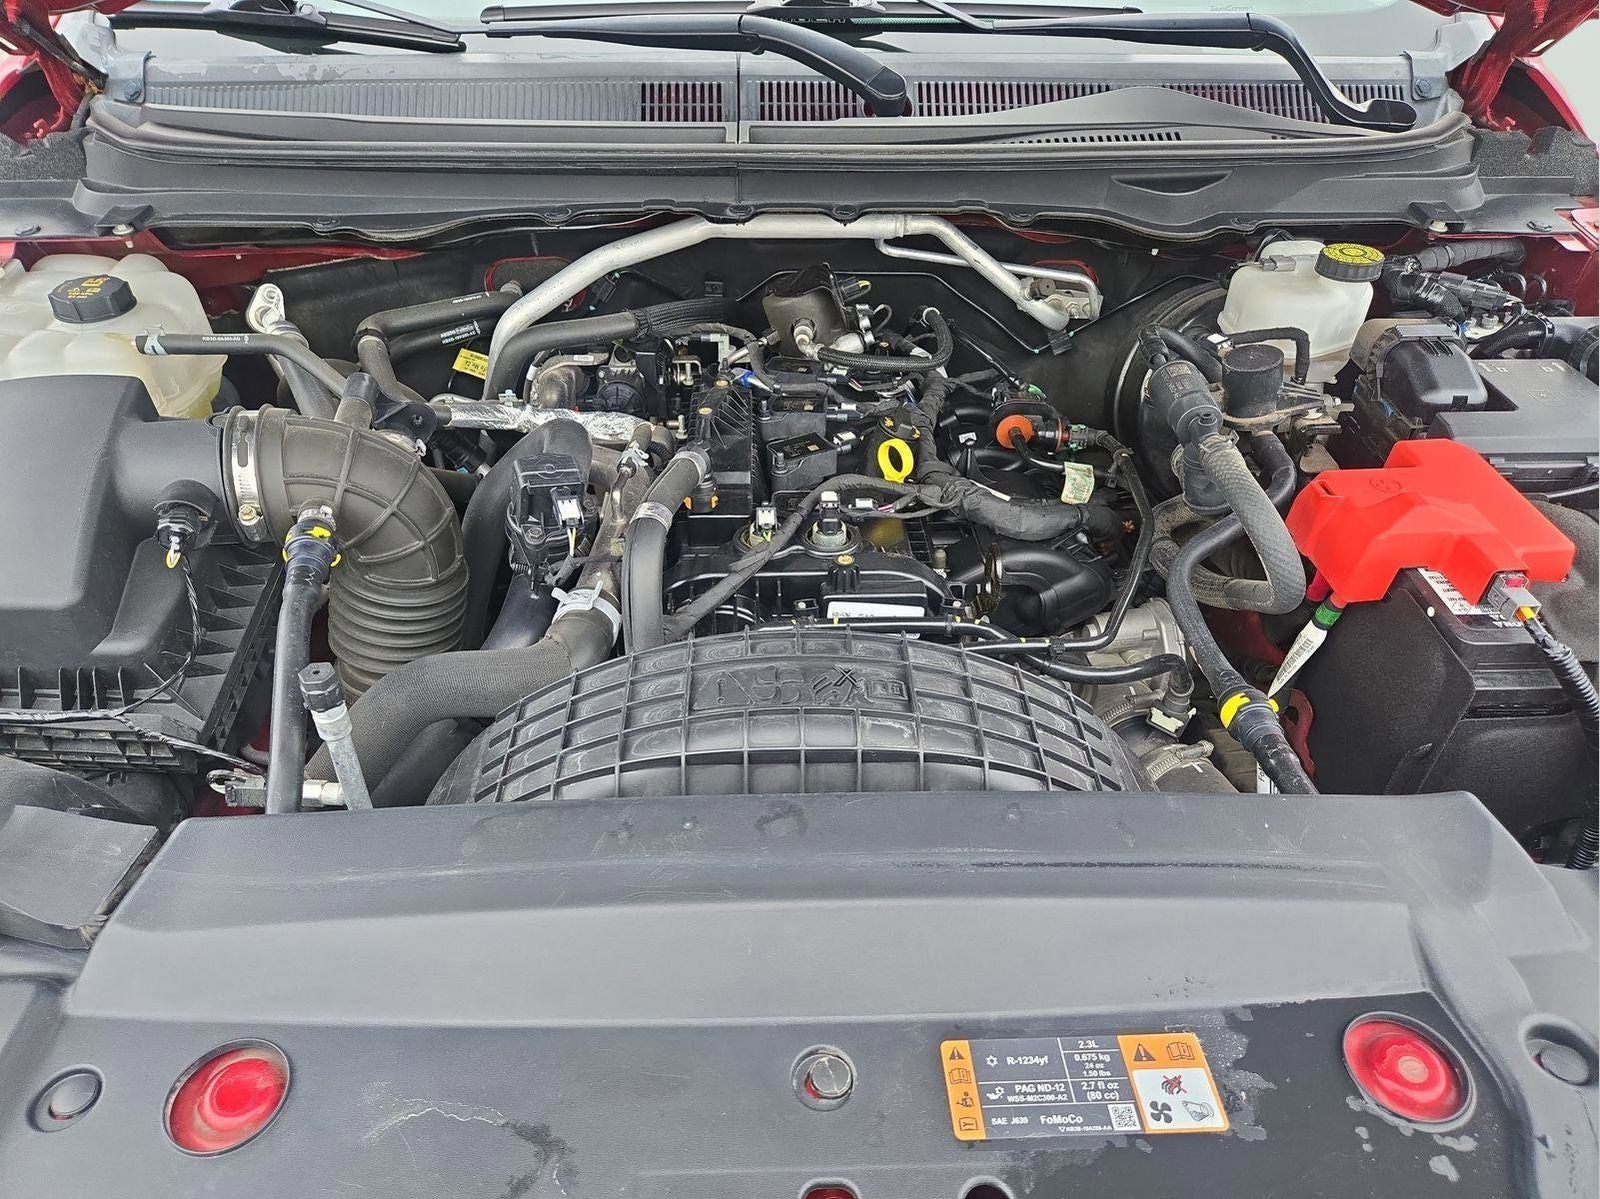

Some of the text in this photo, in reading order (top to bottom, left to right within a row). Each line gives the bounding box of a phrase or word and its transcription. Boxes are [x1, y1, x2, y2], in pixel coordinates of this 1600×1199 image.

[1078, 1040, 1099, 1049] 2.3L
[1006, 1055, 1048, 1066] R-1234yf
[1074, 1053, 1111, 1062] 0.675 kg
[1015, 1083, 1066, 1093] PAG ND-12
[1081, 1081, 1095, 1090] 2.7
[1097, 1081, 1105, 1090] fl
[1087, 1090, 1119, 1101] (80 cc)
[991, 1116, 1028, 1126] SAE J639
[1040, 1114, 1083, 1124] FoMoCo
